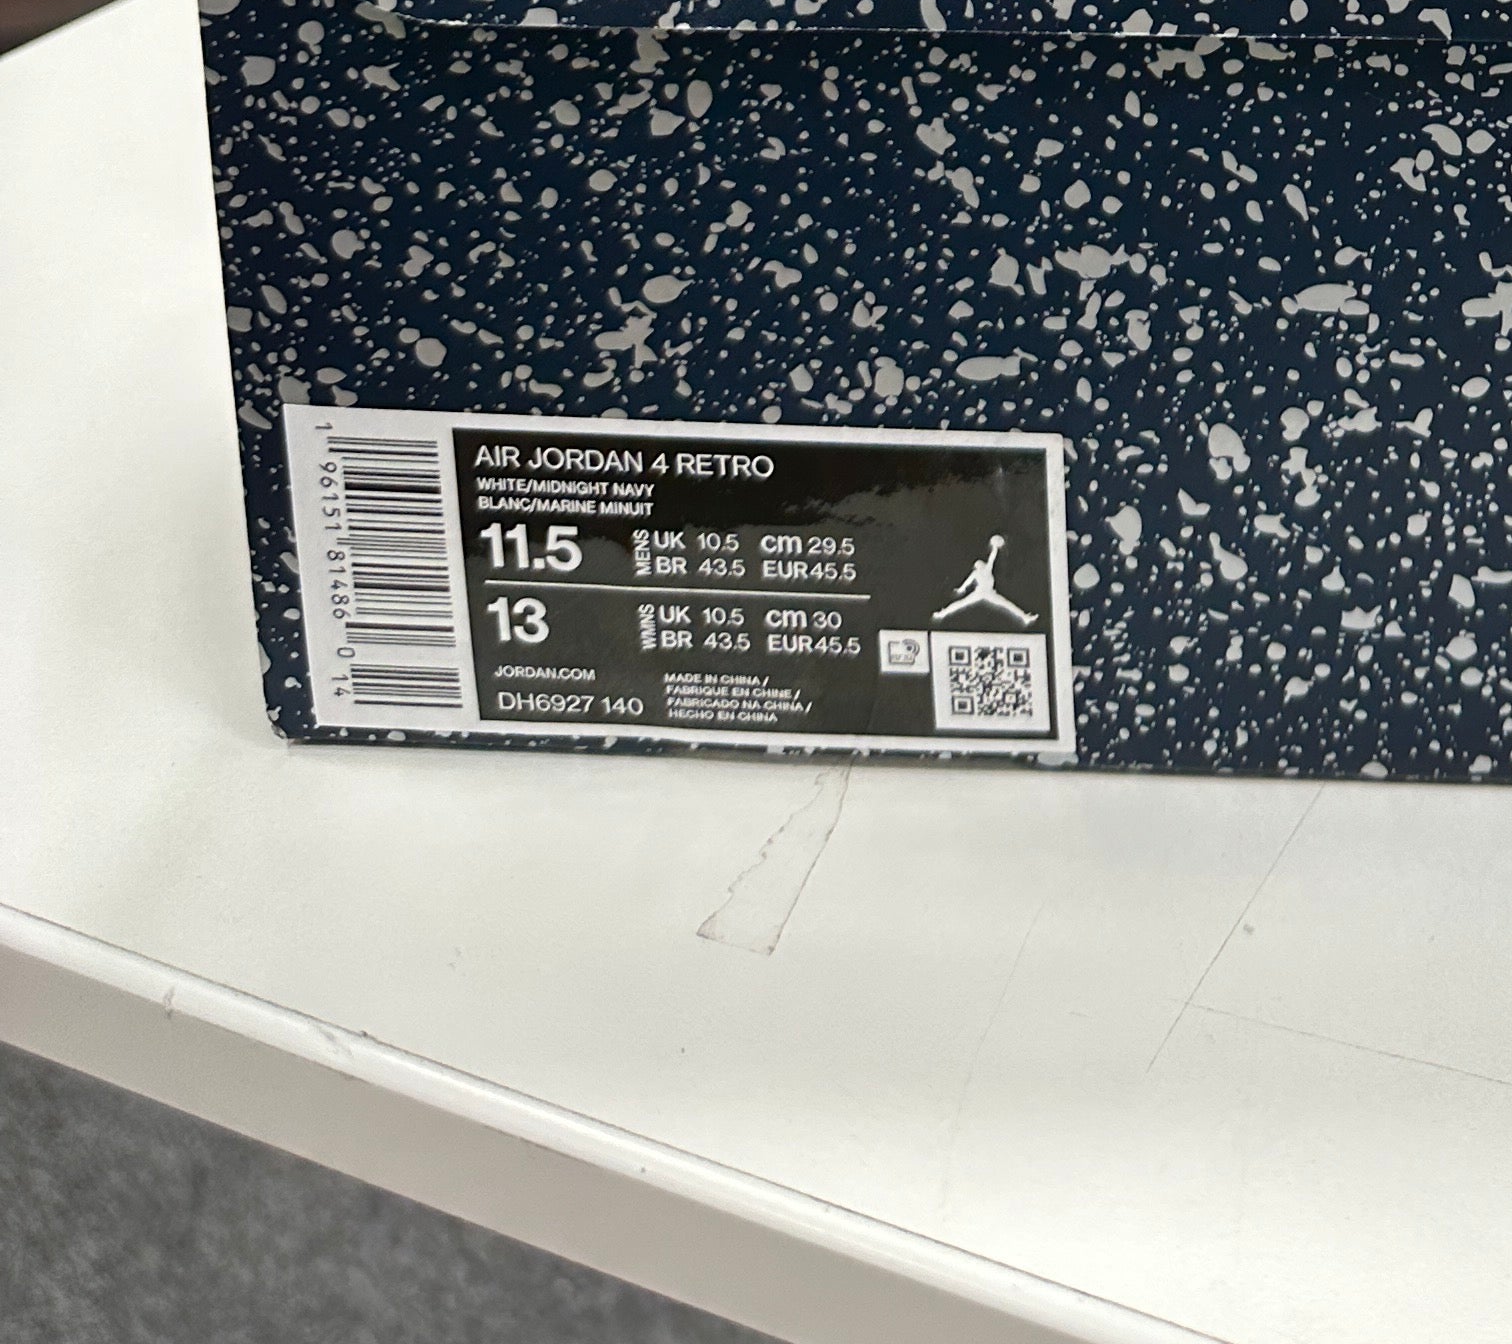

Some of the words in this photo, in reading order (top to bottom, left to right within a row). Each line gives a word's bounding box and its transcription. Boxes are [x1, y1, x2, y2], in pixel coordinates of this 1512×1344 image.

[474, 445, 520, 469] AIR
[528, 447, 643, 473] JORDAN
[651, 452, 669, 474] 4
[676, 453, 774, 478] RETRO
[318, 460, 343, 533] 96151
[476, 477, 608, 496] WHITE/MIDNIGHT
[613, 482, 655, 498] NAVY
[477, 496, 597, 513] BLANC/MARINE
[600, 500, 654, 516] MINUIT
[480, 522, 583, 572] 11.5
[632, 528, 652, 577] MENS
[652, 531, 686, 550] UK
[697, 533, 740, 553] 10.5
[760, 535, 802, 554] cm
[808, 536, 856, 556] 29.5
[655, 556, 687, 575] BR
[698, 558, 746, 577] 43.5
[326, 548, 351, 619] 81486
[486, 595, 551, 644] 13
[638, 603, 657, 651] WMNS
[658, 605, 692, 624] UK
[702, 607, 745, 626] 10.5
[765, 610, 808, 629] cm
[812, 611, 843, 630] 30
[660, 630, 693, 649] BR
[703, 632, 751, 651] 43.5
[494, 665, 596, 682] JORDAN.COM
[664, 673, 702, 684] MADE
[704, 674, 718, 684] IN
[497, 691, 596, 714] DH6927
[600, 694, 645, 716] 140
[666, 685, 729, 696] FABRIQUE
[732, 687, 750, 697] EN
[667, 697, 740, 709] FABRICADO
[741, 699, 761, 709] NA
[668, 709, 714, 719] HECHO
[717, 710, 735, 720] EN
[737, 712, 778, 722] CHINA
